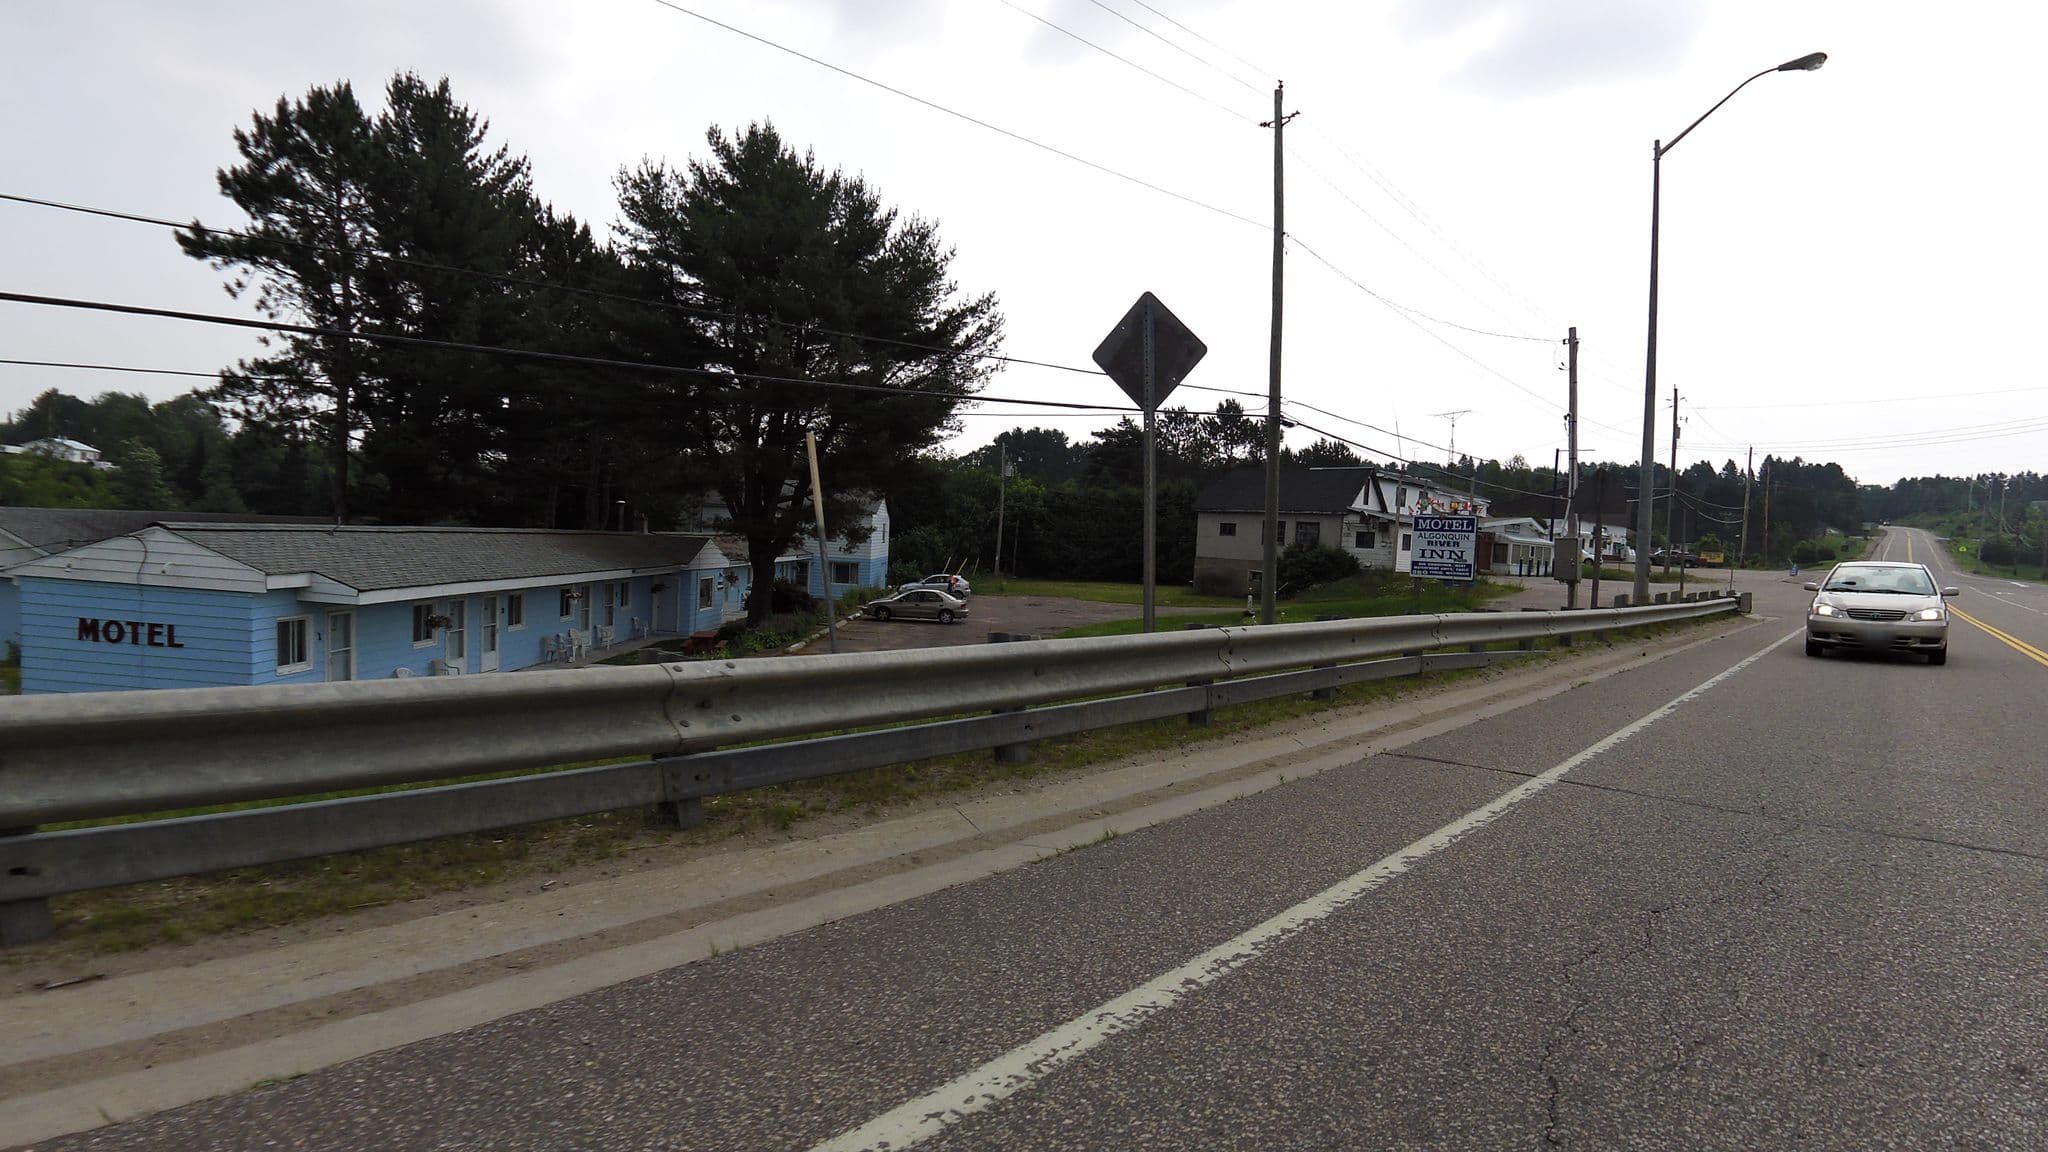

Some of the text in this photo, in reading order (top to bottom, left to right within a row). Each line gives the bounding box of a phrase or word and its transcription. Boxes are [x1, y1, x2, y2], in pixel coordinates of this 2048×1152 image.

[1418, 519, 1472, 531] MOTEL
[1418, 533, 1470, 541] ALGONQUIN
[1419, 549, 1466, 560] INN
[78, 617, 184, 648] MOTEL
